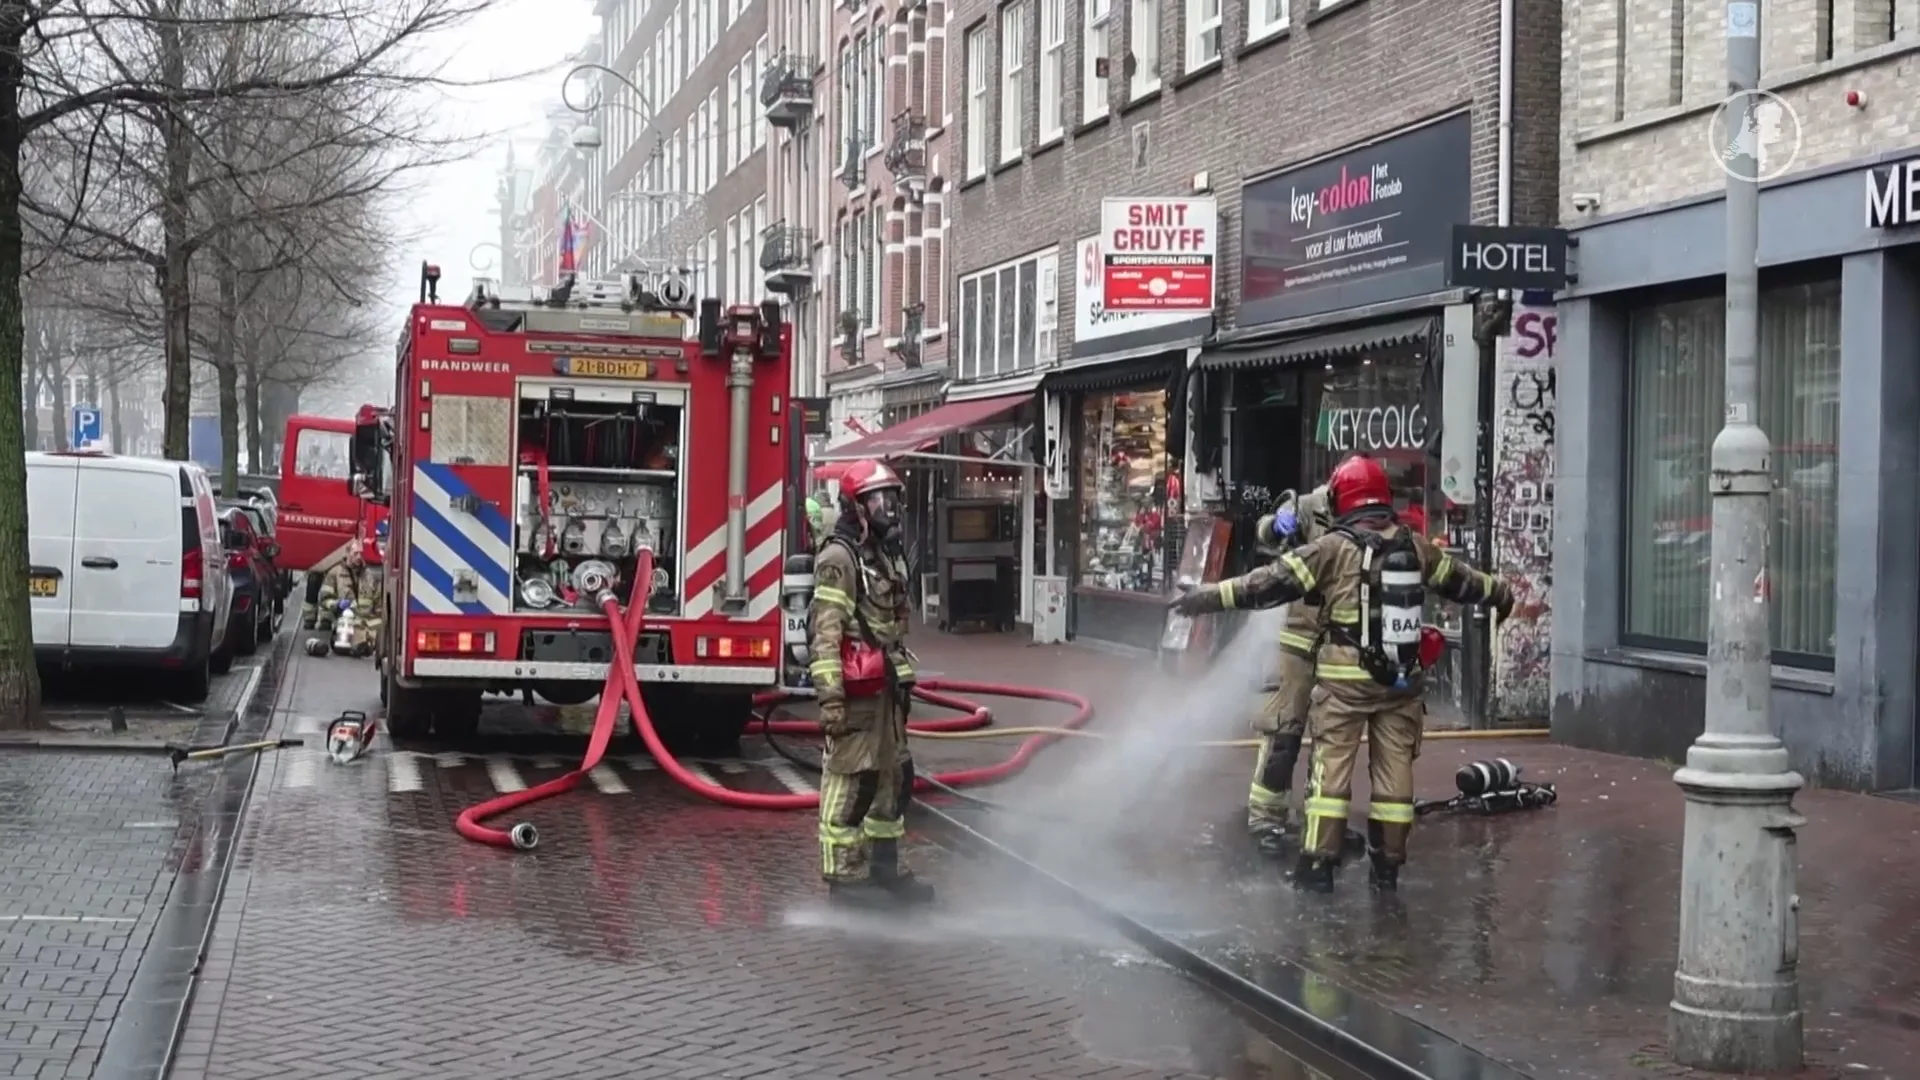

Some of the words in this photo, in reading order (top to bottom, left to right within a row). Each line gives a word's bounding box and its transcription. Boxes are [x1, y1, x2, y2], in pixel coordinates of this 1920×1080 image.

[1128, 203, 1188, 226] SMIT
[1113, 228, 1205, 250] CRUYFF
[1305, 240, 1323, 259] voor
[1324, 235, 1332, 255] al
[1333, 236, 1346, 253] uw
[1347, 224, 1383, 250] fotowerk
[1112, 255, 1205, 265] SPORTSPECIALISTEN
[1462, 242, 1556, 272] HOTEL
[421, 359, 510, 373] BRANDWEER
[576, 360, 642, 376] 21-BDH-7
[80, 411, 95, 433] P
